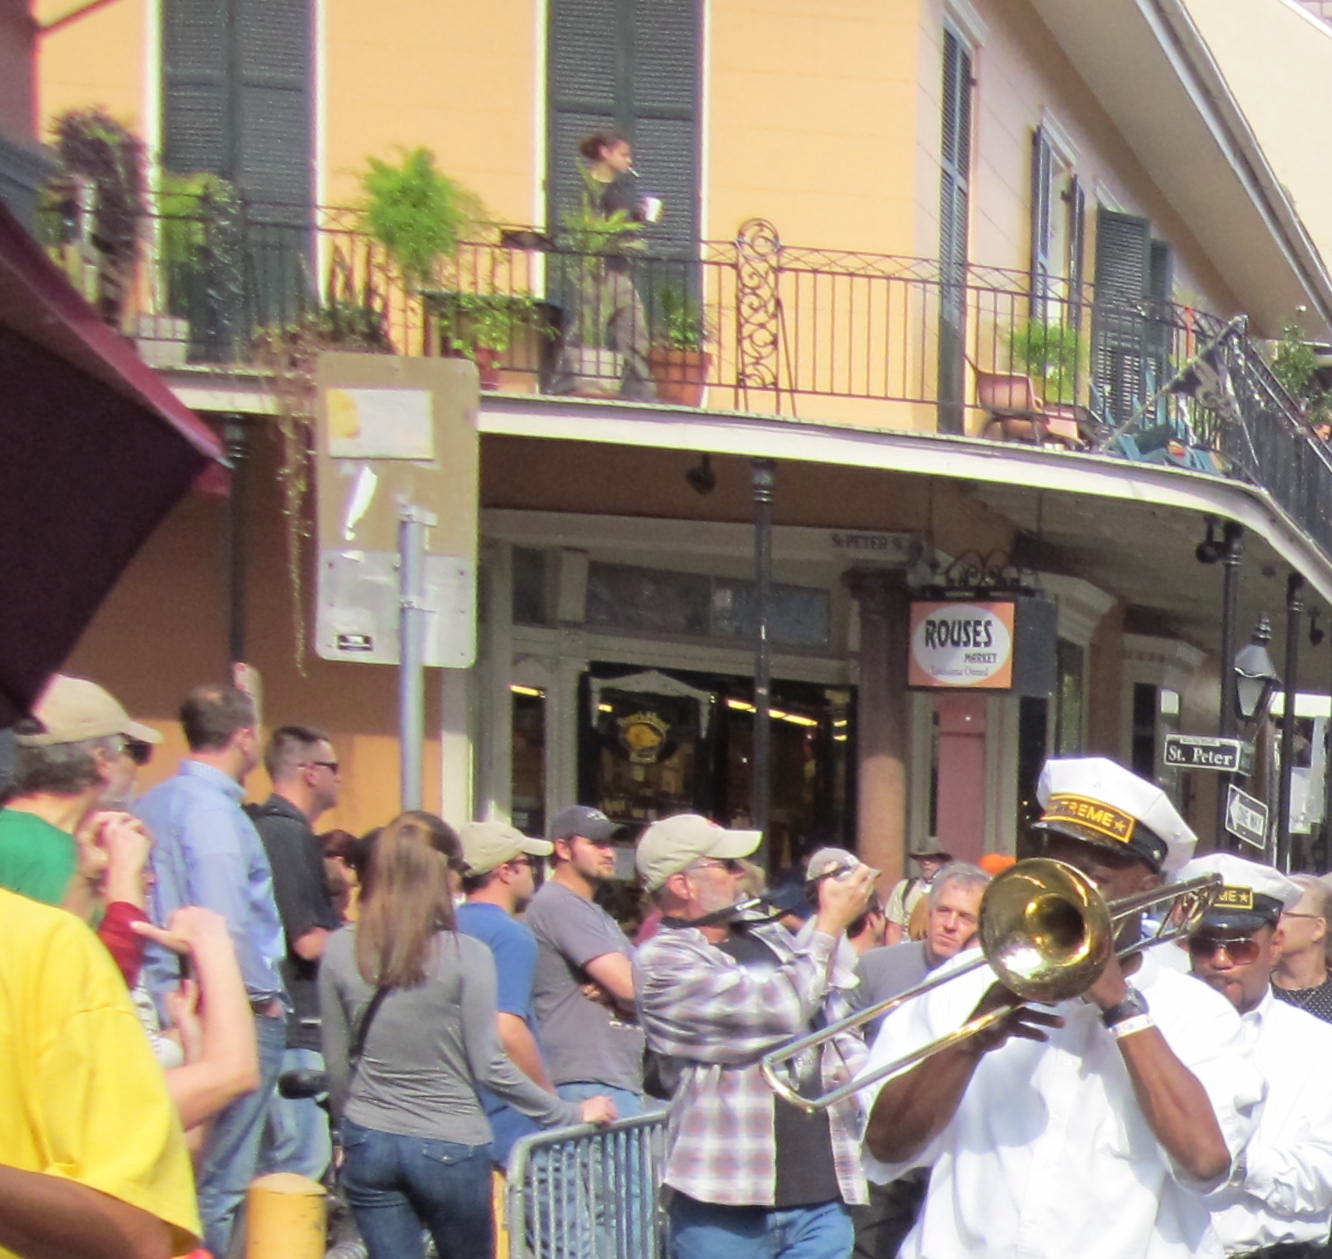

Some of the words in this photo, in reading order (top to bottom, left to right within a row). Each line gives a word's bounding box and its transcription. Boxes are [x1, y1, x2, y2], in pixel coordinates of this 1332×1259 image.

[846, 535, 888, 550] PETER
[925, 619, 993, 650] ROUSES
[964, 652, 998, 664] MARKET
[1168, 745, 1186, 762] St.
[1192, 747, 1234, 766] Peter
